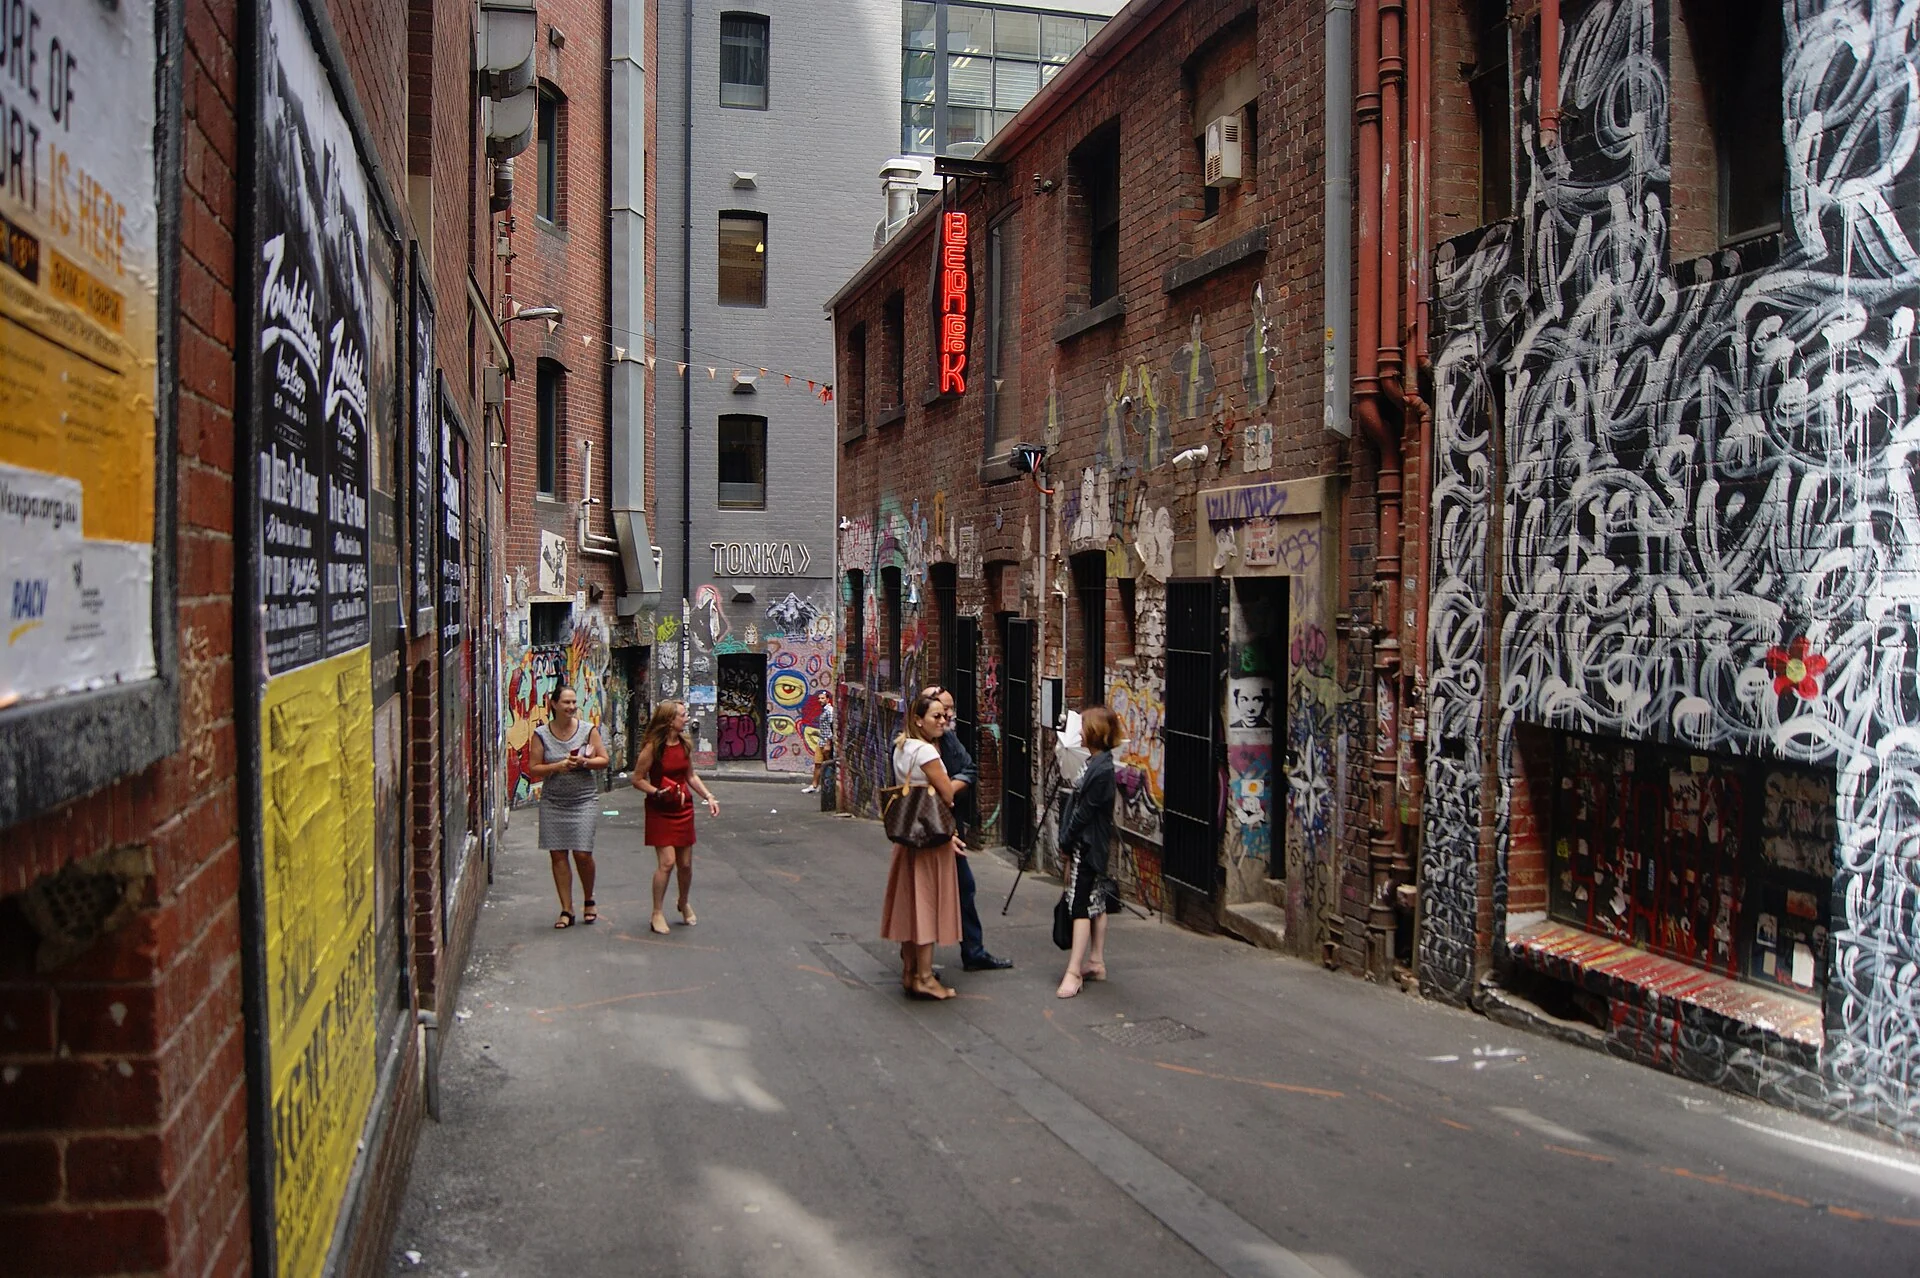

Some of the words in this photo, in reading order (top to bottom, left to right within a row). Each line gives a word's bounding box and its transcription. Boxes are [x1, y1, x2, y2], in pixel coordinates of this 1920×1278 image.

[50, 35, 77, 132] OF
[51, 142, 71, 237] IS
[78, 166, 126, 277] HERE
[710, 542, 794, 575] TONKA
